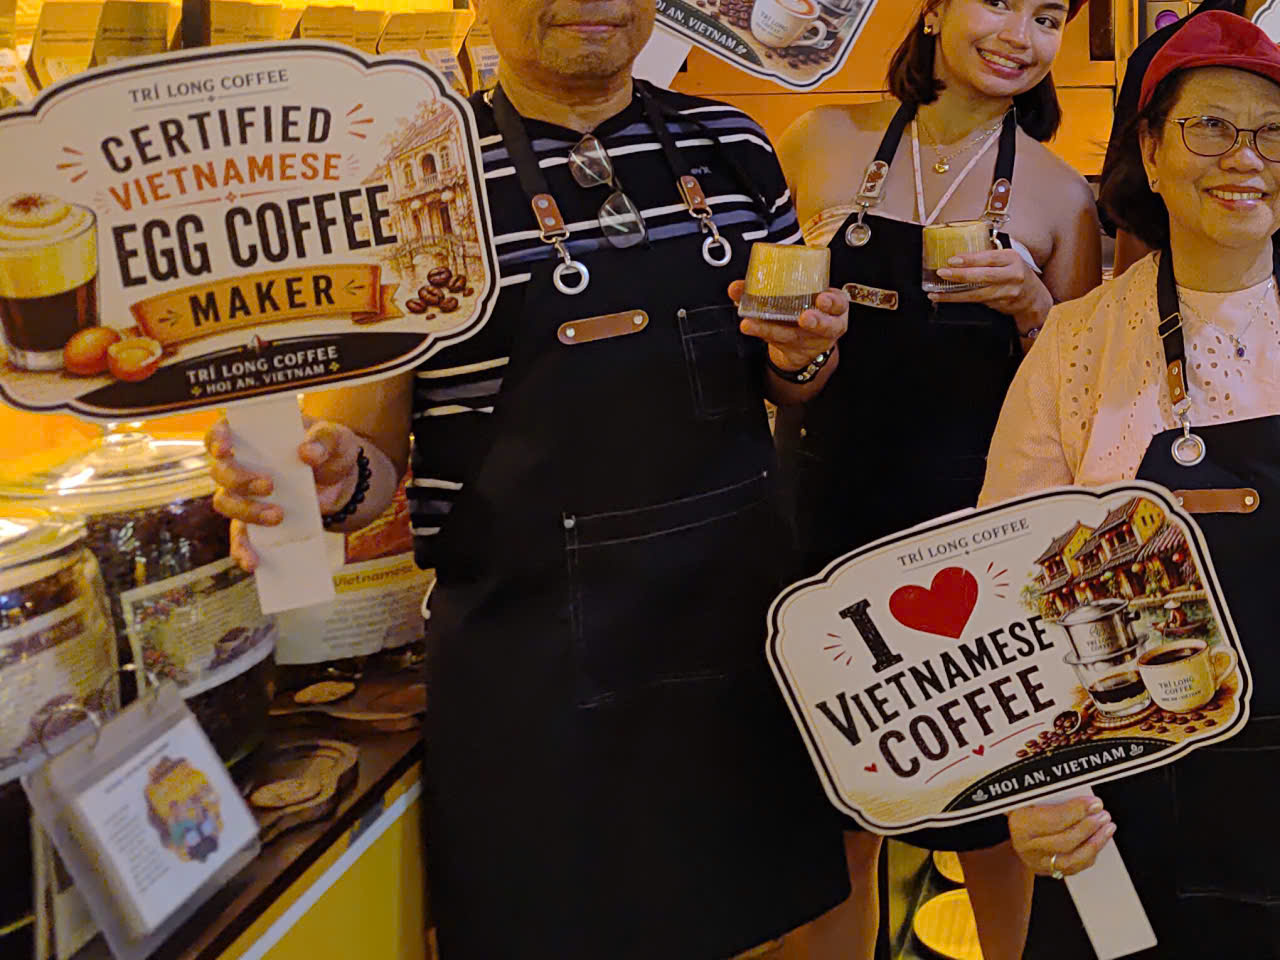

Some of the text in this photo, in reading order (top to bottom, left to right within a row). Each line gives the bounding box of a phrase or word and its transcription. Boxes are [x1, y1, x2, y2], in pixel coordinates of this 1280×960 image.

[688, 16, 737, 50] VIETNAM
[128, 68, 290, 104] TRÍ LONG COFFEE
[101, 105, 333, 174] CERTIFIED
[109, 153, 342, 212] VIETNAMESE
[112, 184, 398, 288] EGG COFFEE
[189, 274, 335, 327] MAKER
[186, 345, 339, 386] TRÍ LONG COFFEE
[206, 382, 232, 395] HOI
[262, 363, 326, 385] VIETNAM
[896, 517, 1031, 568] TRÍ LONG COFFEE
[838, 598, 904, 673] I
[815, 614, 1055, 747] VIETNAMESE
[878, 664, 1056, 778] COFFEE
[988, 745, 1127, 798] HOI AN, VIETNAM
